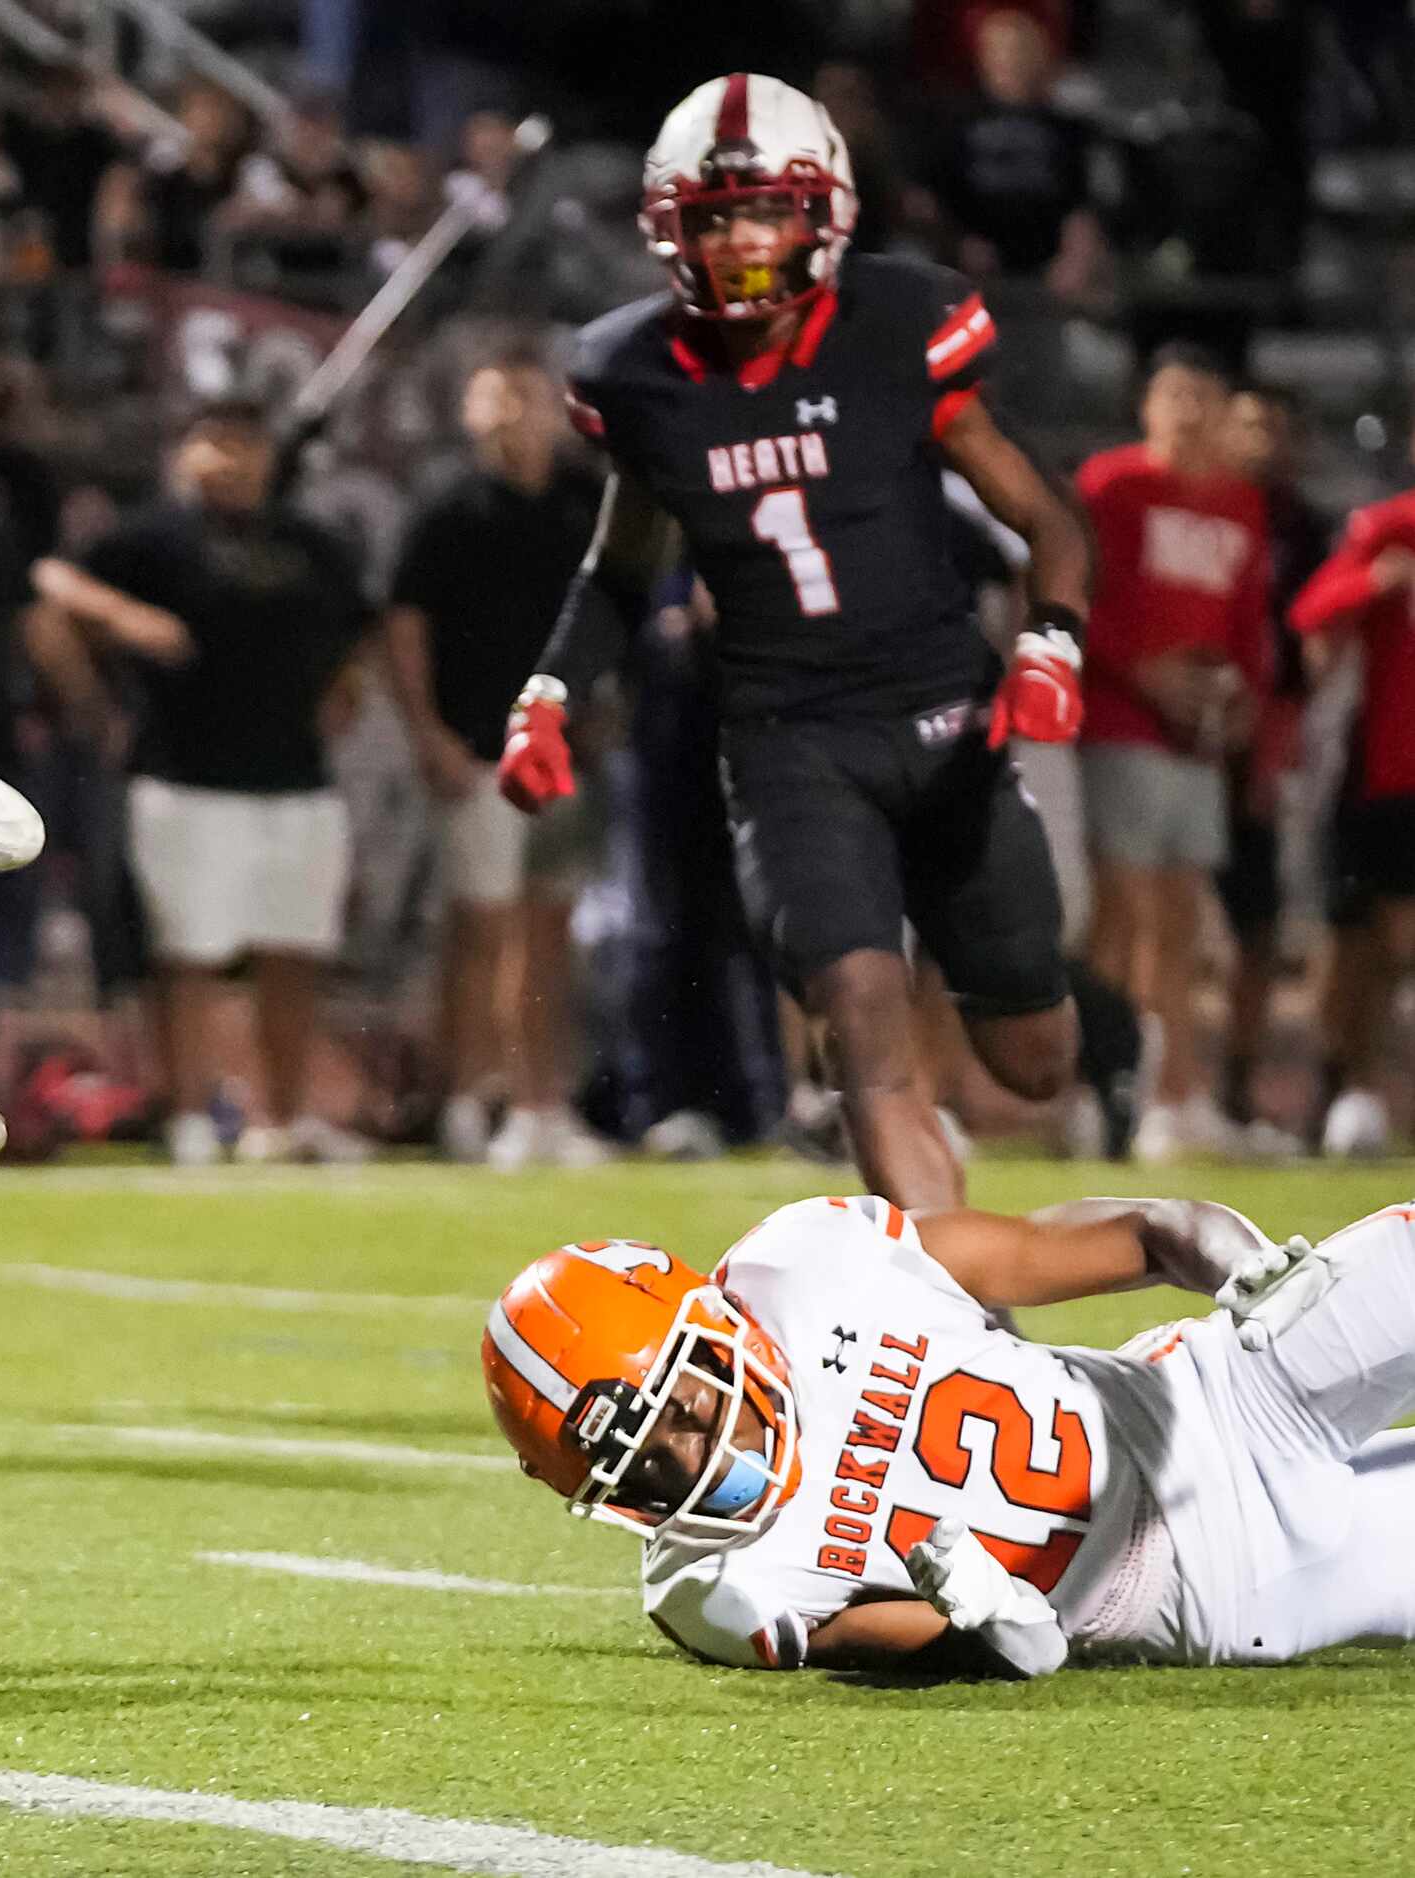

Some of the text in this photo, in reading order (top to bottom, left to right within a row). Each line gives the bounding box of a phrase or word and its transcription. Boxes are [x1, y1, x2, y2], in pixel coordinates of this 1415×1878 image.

[707, 432, 829, 494] HEATH
[751, 486, 841, 617] 1
[817, 1332, 930, 1577] ROCKWALL
